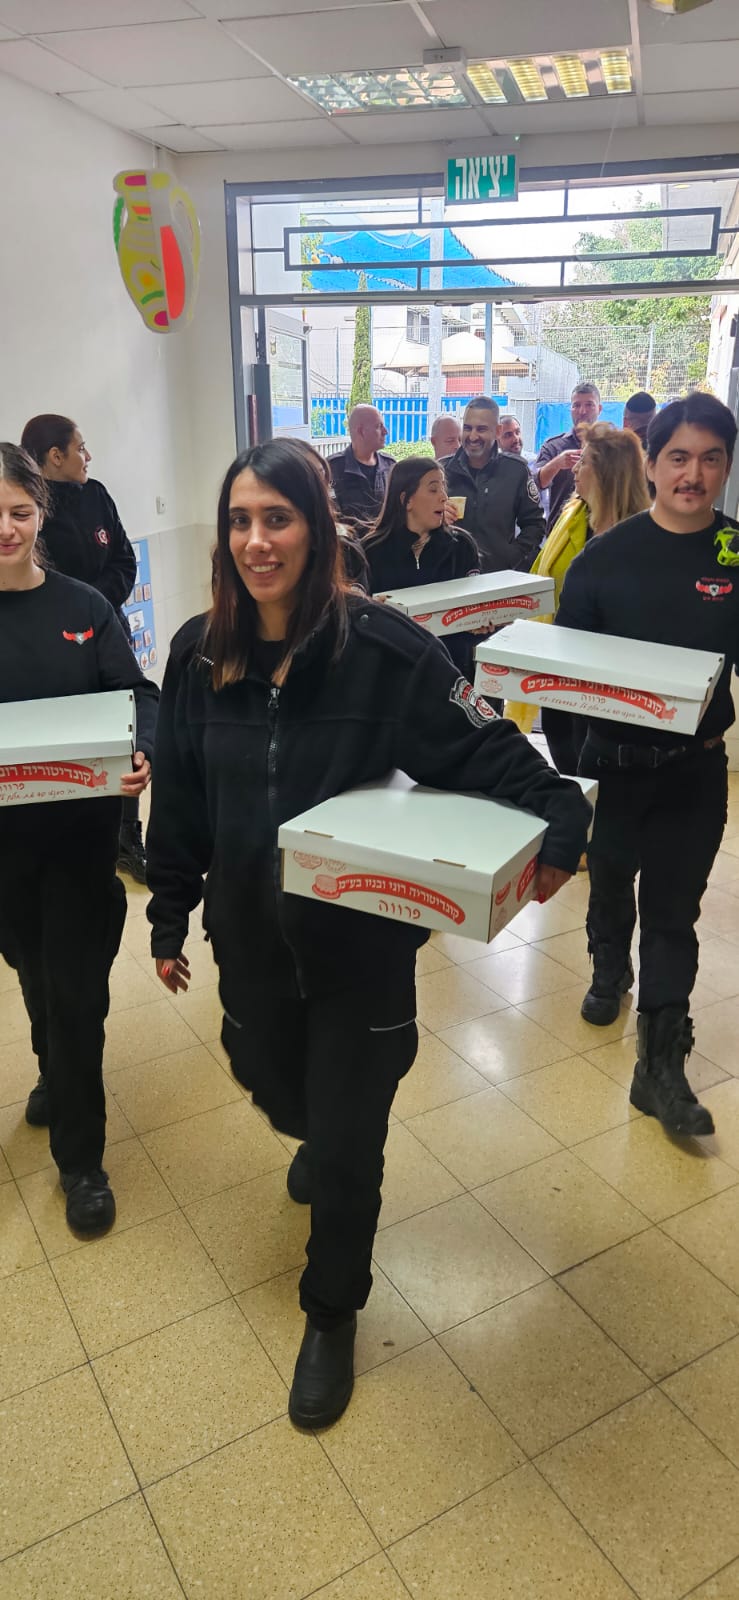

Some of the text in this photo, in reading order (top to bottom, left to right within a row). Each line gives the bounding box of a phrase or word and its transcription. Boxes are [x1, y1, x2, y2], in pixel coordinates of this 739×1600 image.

[455, 155, 508, 200] יציאה
[608, 687, 663, 716] קונדיטוריה
[22, 765, 92, 785] קונדיטוריה
[339, 879, 460, 920] קונדיטוריה רוני ובניו בע"מ
[379, 899, 421, 919] פרווה
